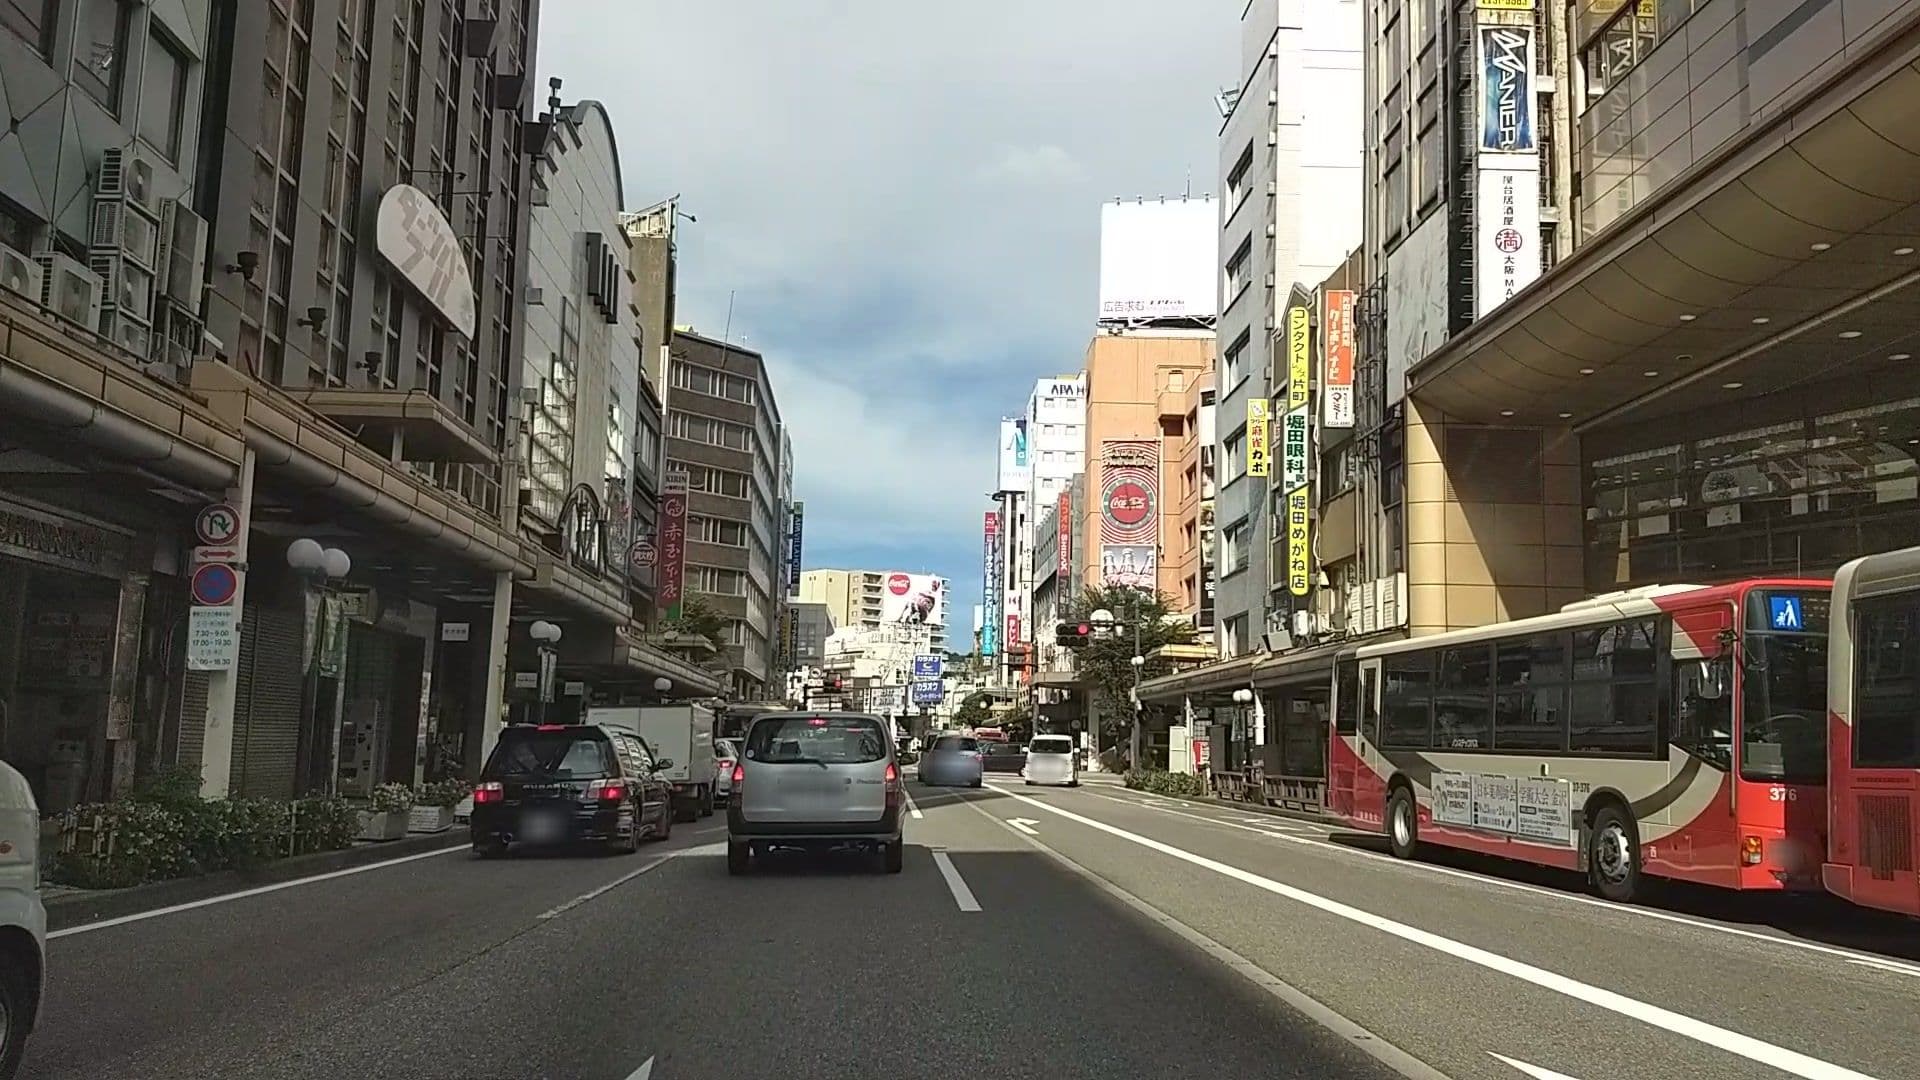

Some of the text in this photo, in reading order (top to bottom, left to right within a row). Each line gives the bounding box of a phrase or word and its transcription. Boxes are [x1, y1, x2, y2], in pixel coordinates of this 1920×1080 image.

[1503, 175, 1514, 226] 屋台居酒屋
[1495, 230, 1520, 251] 満
[1504, 255, 1515, 275] 大阪
[1103, 300, 1145, 312] 広告求む
[1051, 384, 1073, 396] APA
[1291, 495, 1306, 589] 堀田めがね店
[1769, 788, 1798, 801] 376
